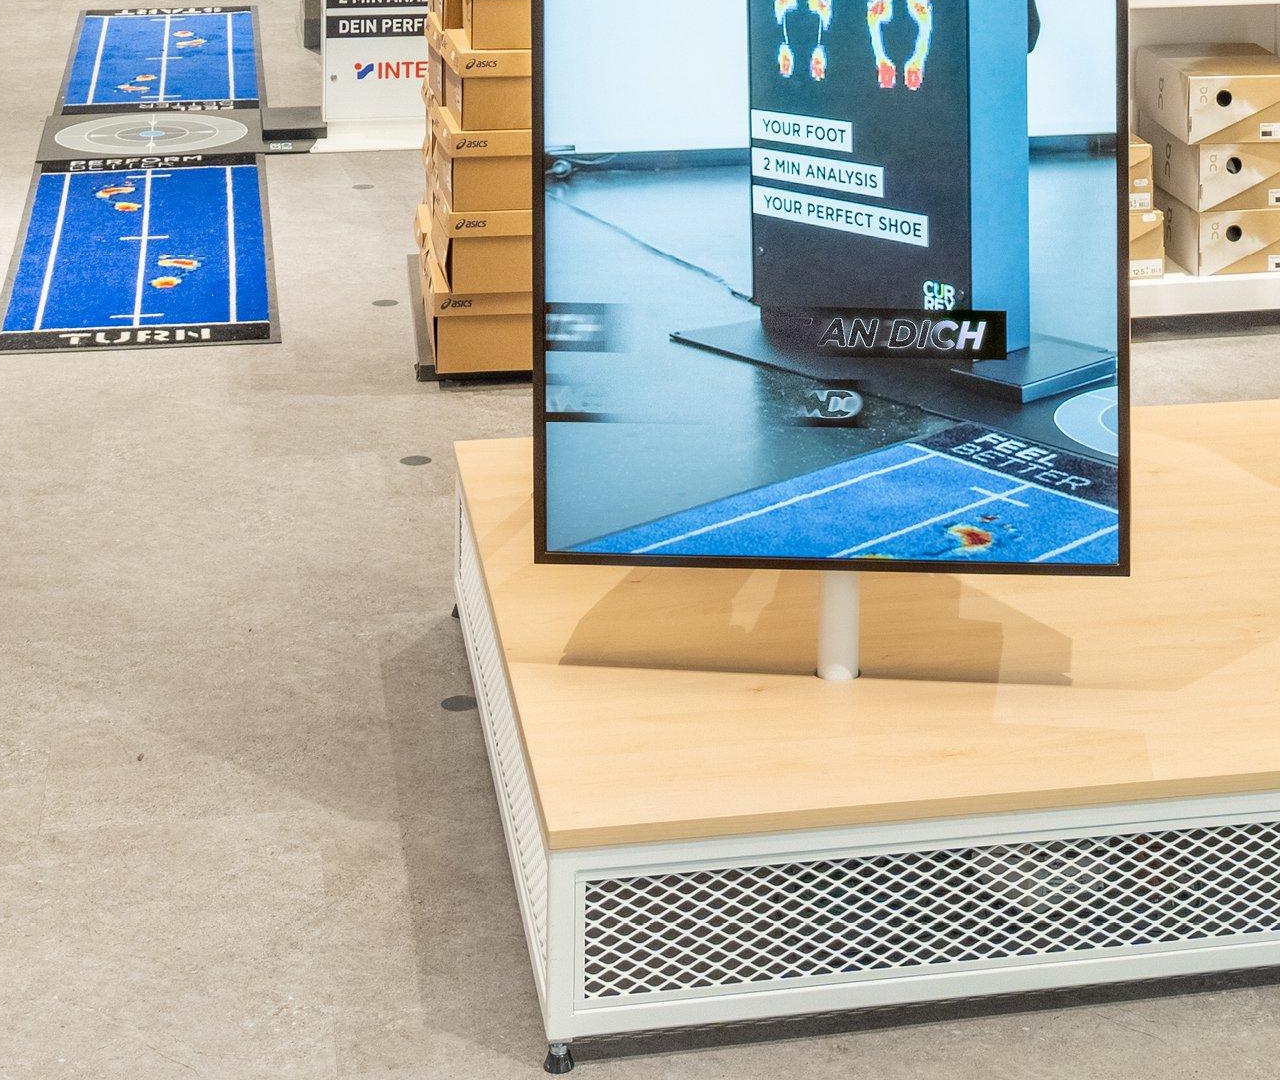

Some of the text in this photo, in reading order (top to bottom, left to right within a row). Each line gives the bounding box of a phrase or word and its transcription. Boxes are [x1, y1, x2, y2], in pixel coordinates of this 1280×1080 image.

[339, 18, 427, 34] DEIN PERF
[377, 61, 428, 79] INTE
[475, 60, 497, 68] asics
[762, 118, 846, 143] YOUR FOOT
[466, 140, 488, 148] asics
[763, 157, 878, 189] 2 MIN ANALYSIS
[465, 220, 487, 228] asics
[764, 194, 922, 238] YOUR PERFECT SHOE
[922, 280, 956, 297] CUR
[451, 299, 473, 308] asics
[58, 328, 211, 345] TURN
[818, 317, 987, 351] AN DICH
[974, 433, 1058, 467] FEEL
[951, 443, 1091, 491] BETTER
